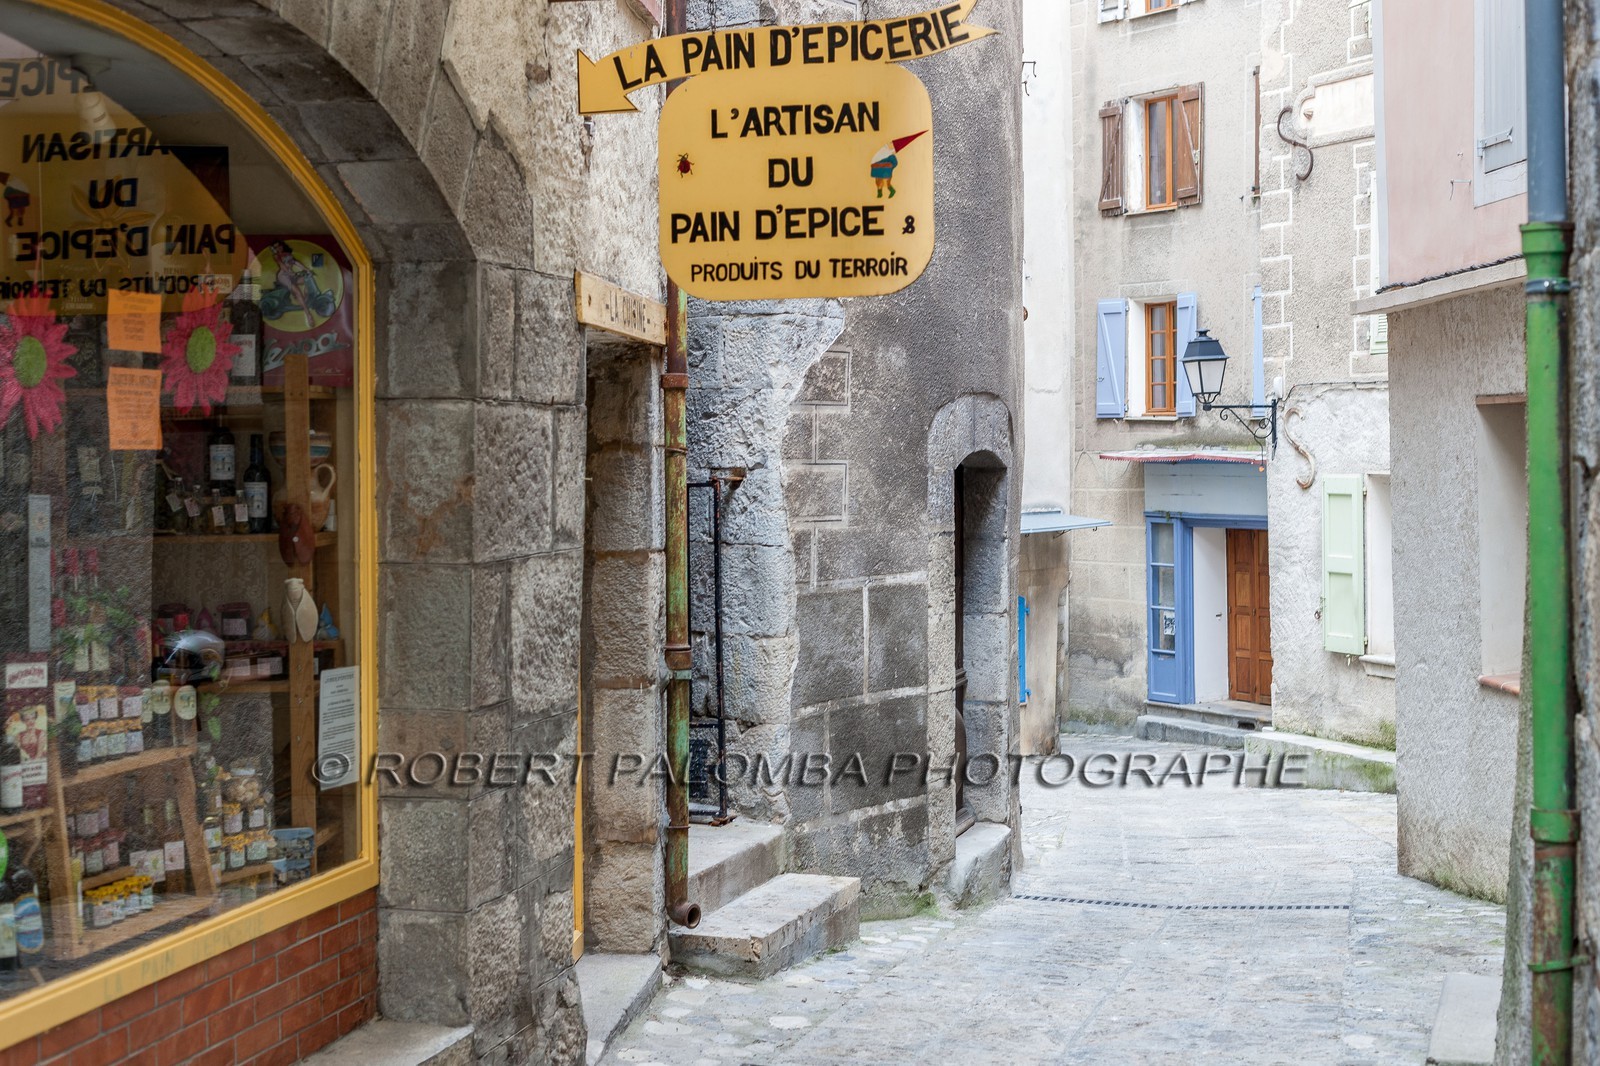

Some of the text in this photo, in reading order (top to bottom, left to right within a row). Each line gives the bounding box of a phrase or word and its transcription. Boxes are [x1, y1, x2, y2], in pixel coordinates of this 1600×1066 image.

[612, 4, 971, 91] LA PAIN D'EPICERIE
[710, 101, 880, 139] L'ARTISAN
[768, 156, 814, 188] DU
[671, 204, 916, 244] PAIN D'EPICE &
[795, 258, 821, 280] DU
